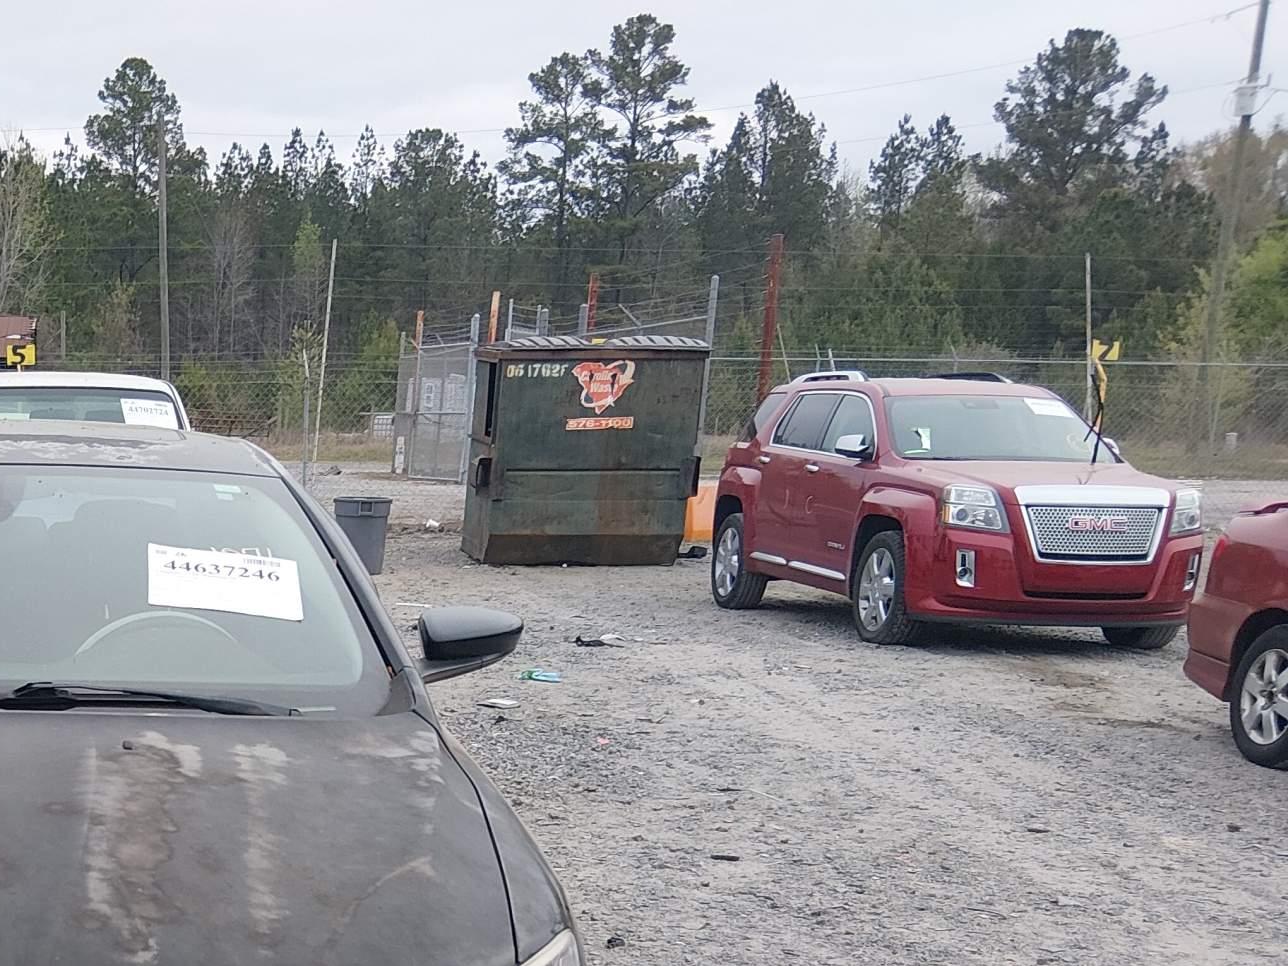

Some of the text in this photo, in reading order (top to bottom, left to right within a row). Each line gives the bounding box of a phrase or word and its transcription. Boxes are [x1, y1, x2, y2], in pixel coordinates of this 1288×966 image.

[11, 345, 26, 365] 5
[1068, 517, 1129, 532] GMC
[163, 559, 281, 582] 44637246
